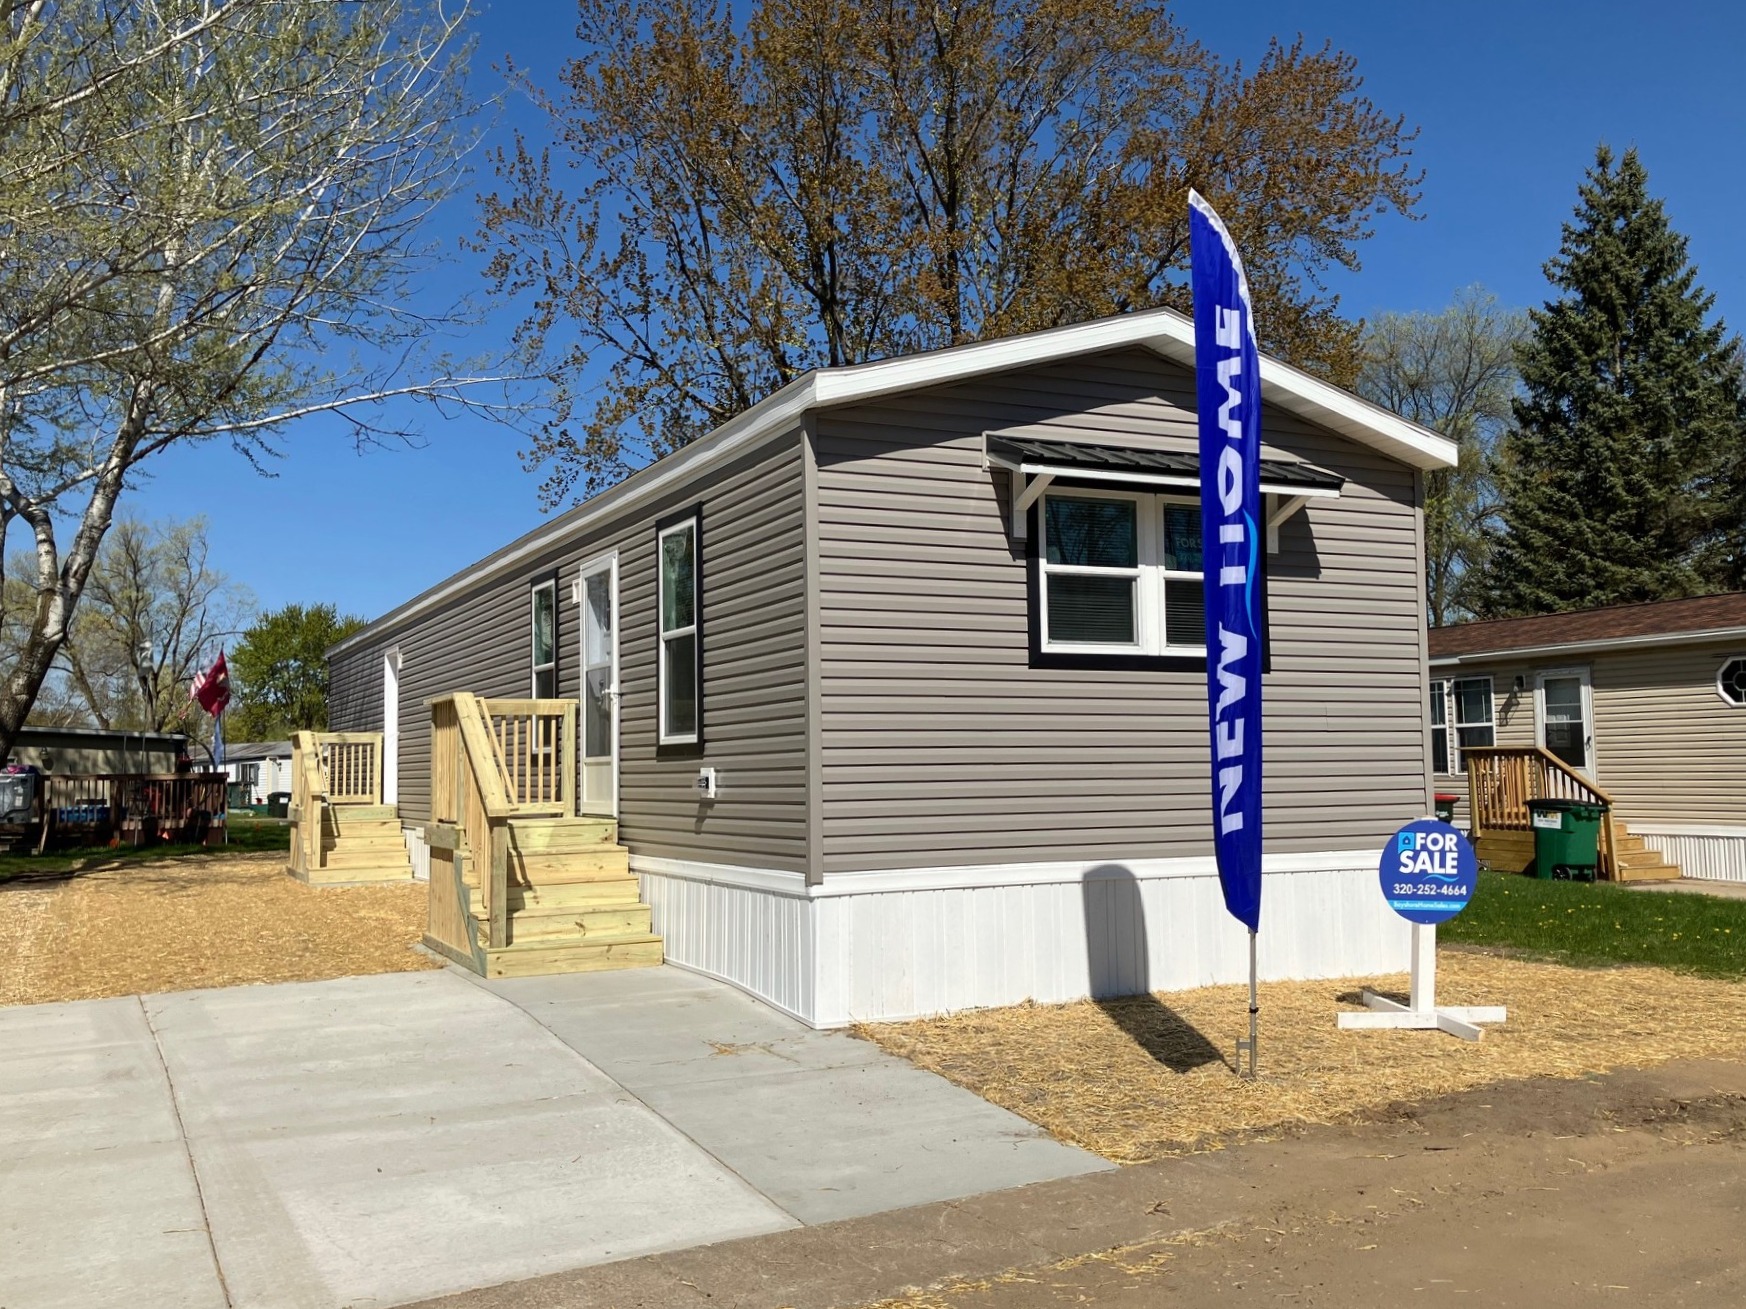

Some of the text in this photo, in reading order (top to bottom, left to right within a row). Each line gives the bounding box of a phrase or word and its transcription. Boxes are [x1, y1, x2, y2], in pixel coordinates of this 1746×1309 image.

[1215, 304, 1247, 839] NEW HOME
[1415, 832, 1458, 851] FOR
[1398, 850, 1458, 874] SALE
[1393, 883, 1467, 896] 320-252-4664
